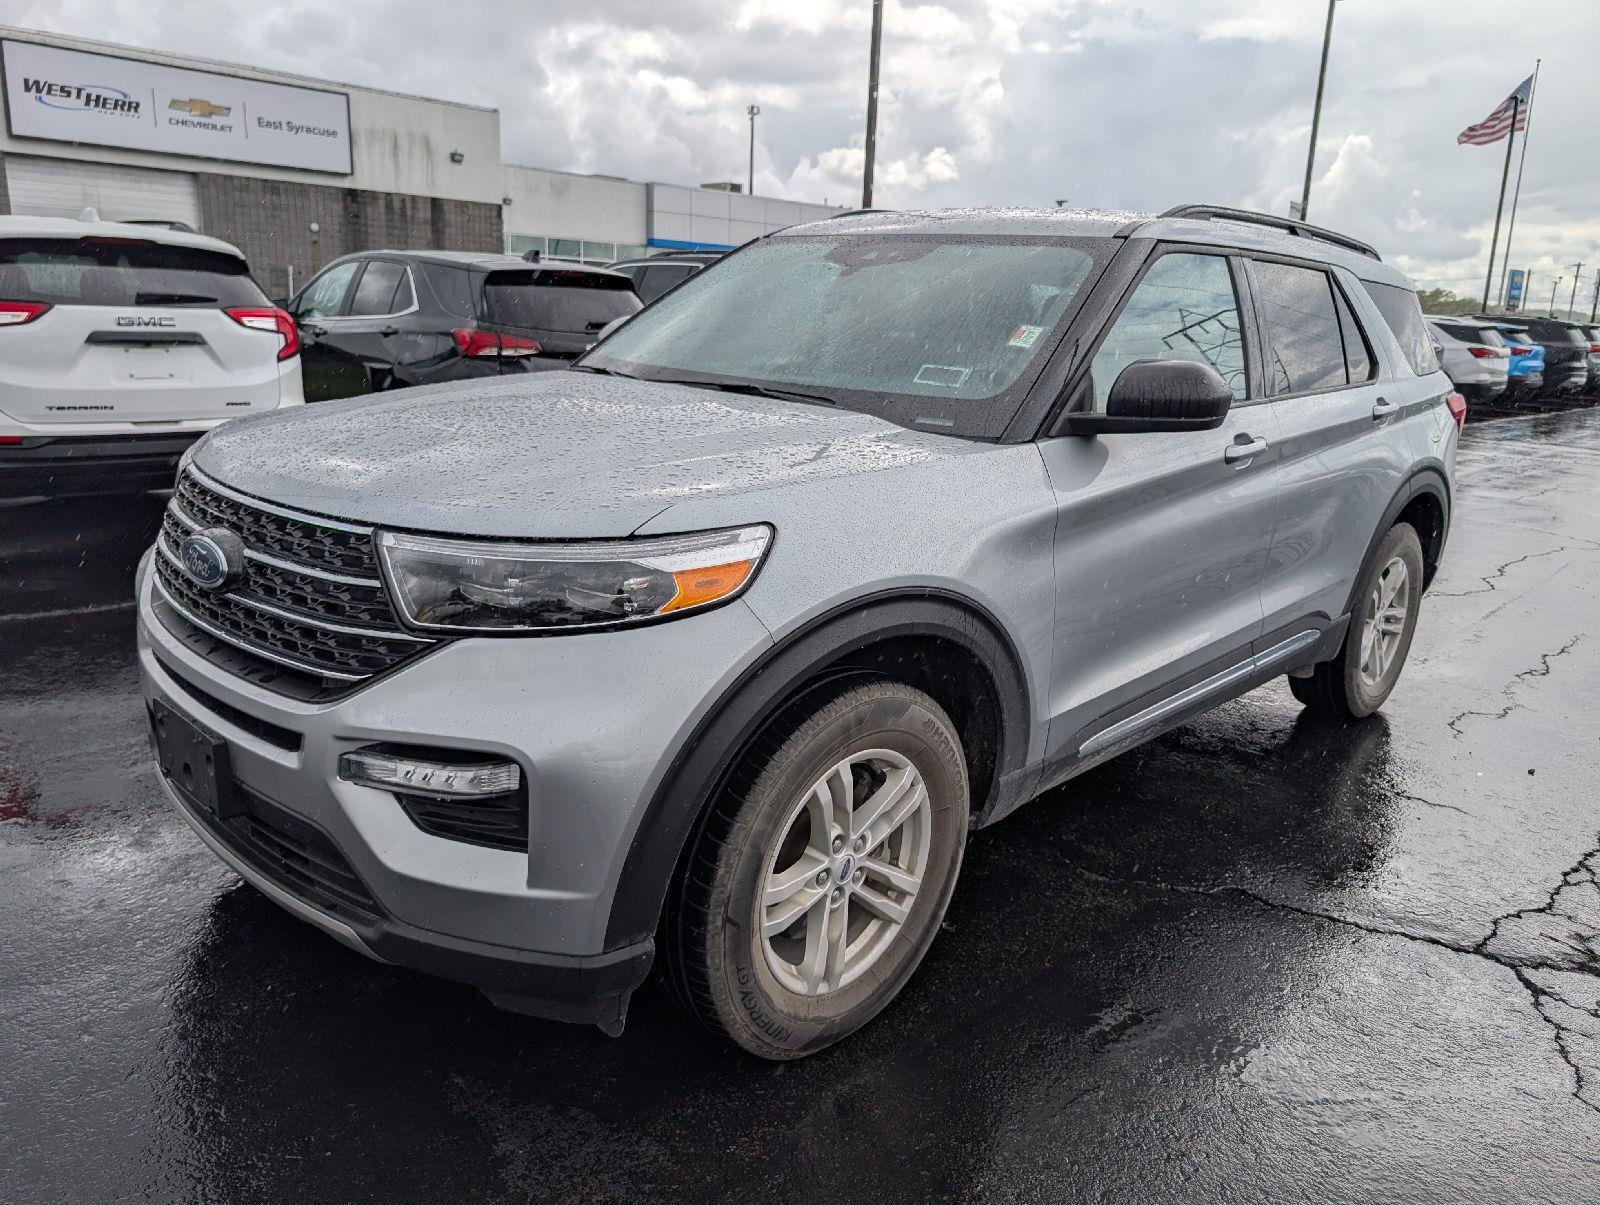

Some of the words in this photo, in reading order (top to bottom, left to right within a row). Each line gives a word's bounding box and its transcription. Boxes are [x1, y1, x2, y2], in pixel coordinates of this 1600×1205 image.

[23, 78, 86, 100] WEST
[84, 92, 141, 113] HERR
[168, 117, 233, 134] CHEVROLET
[257, 115, 283, 131] East
[286, 120, 338, 138] Syracuse
[116, 317, 176, 327] GMC
